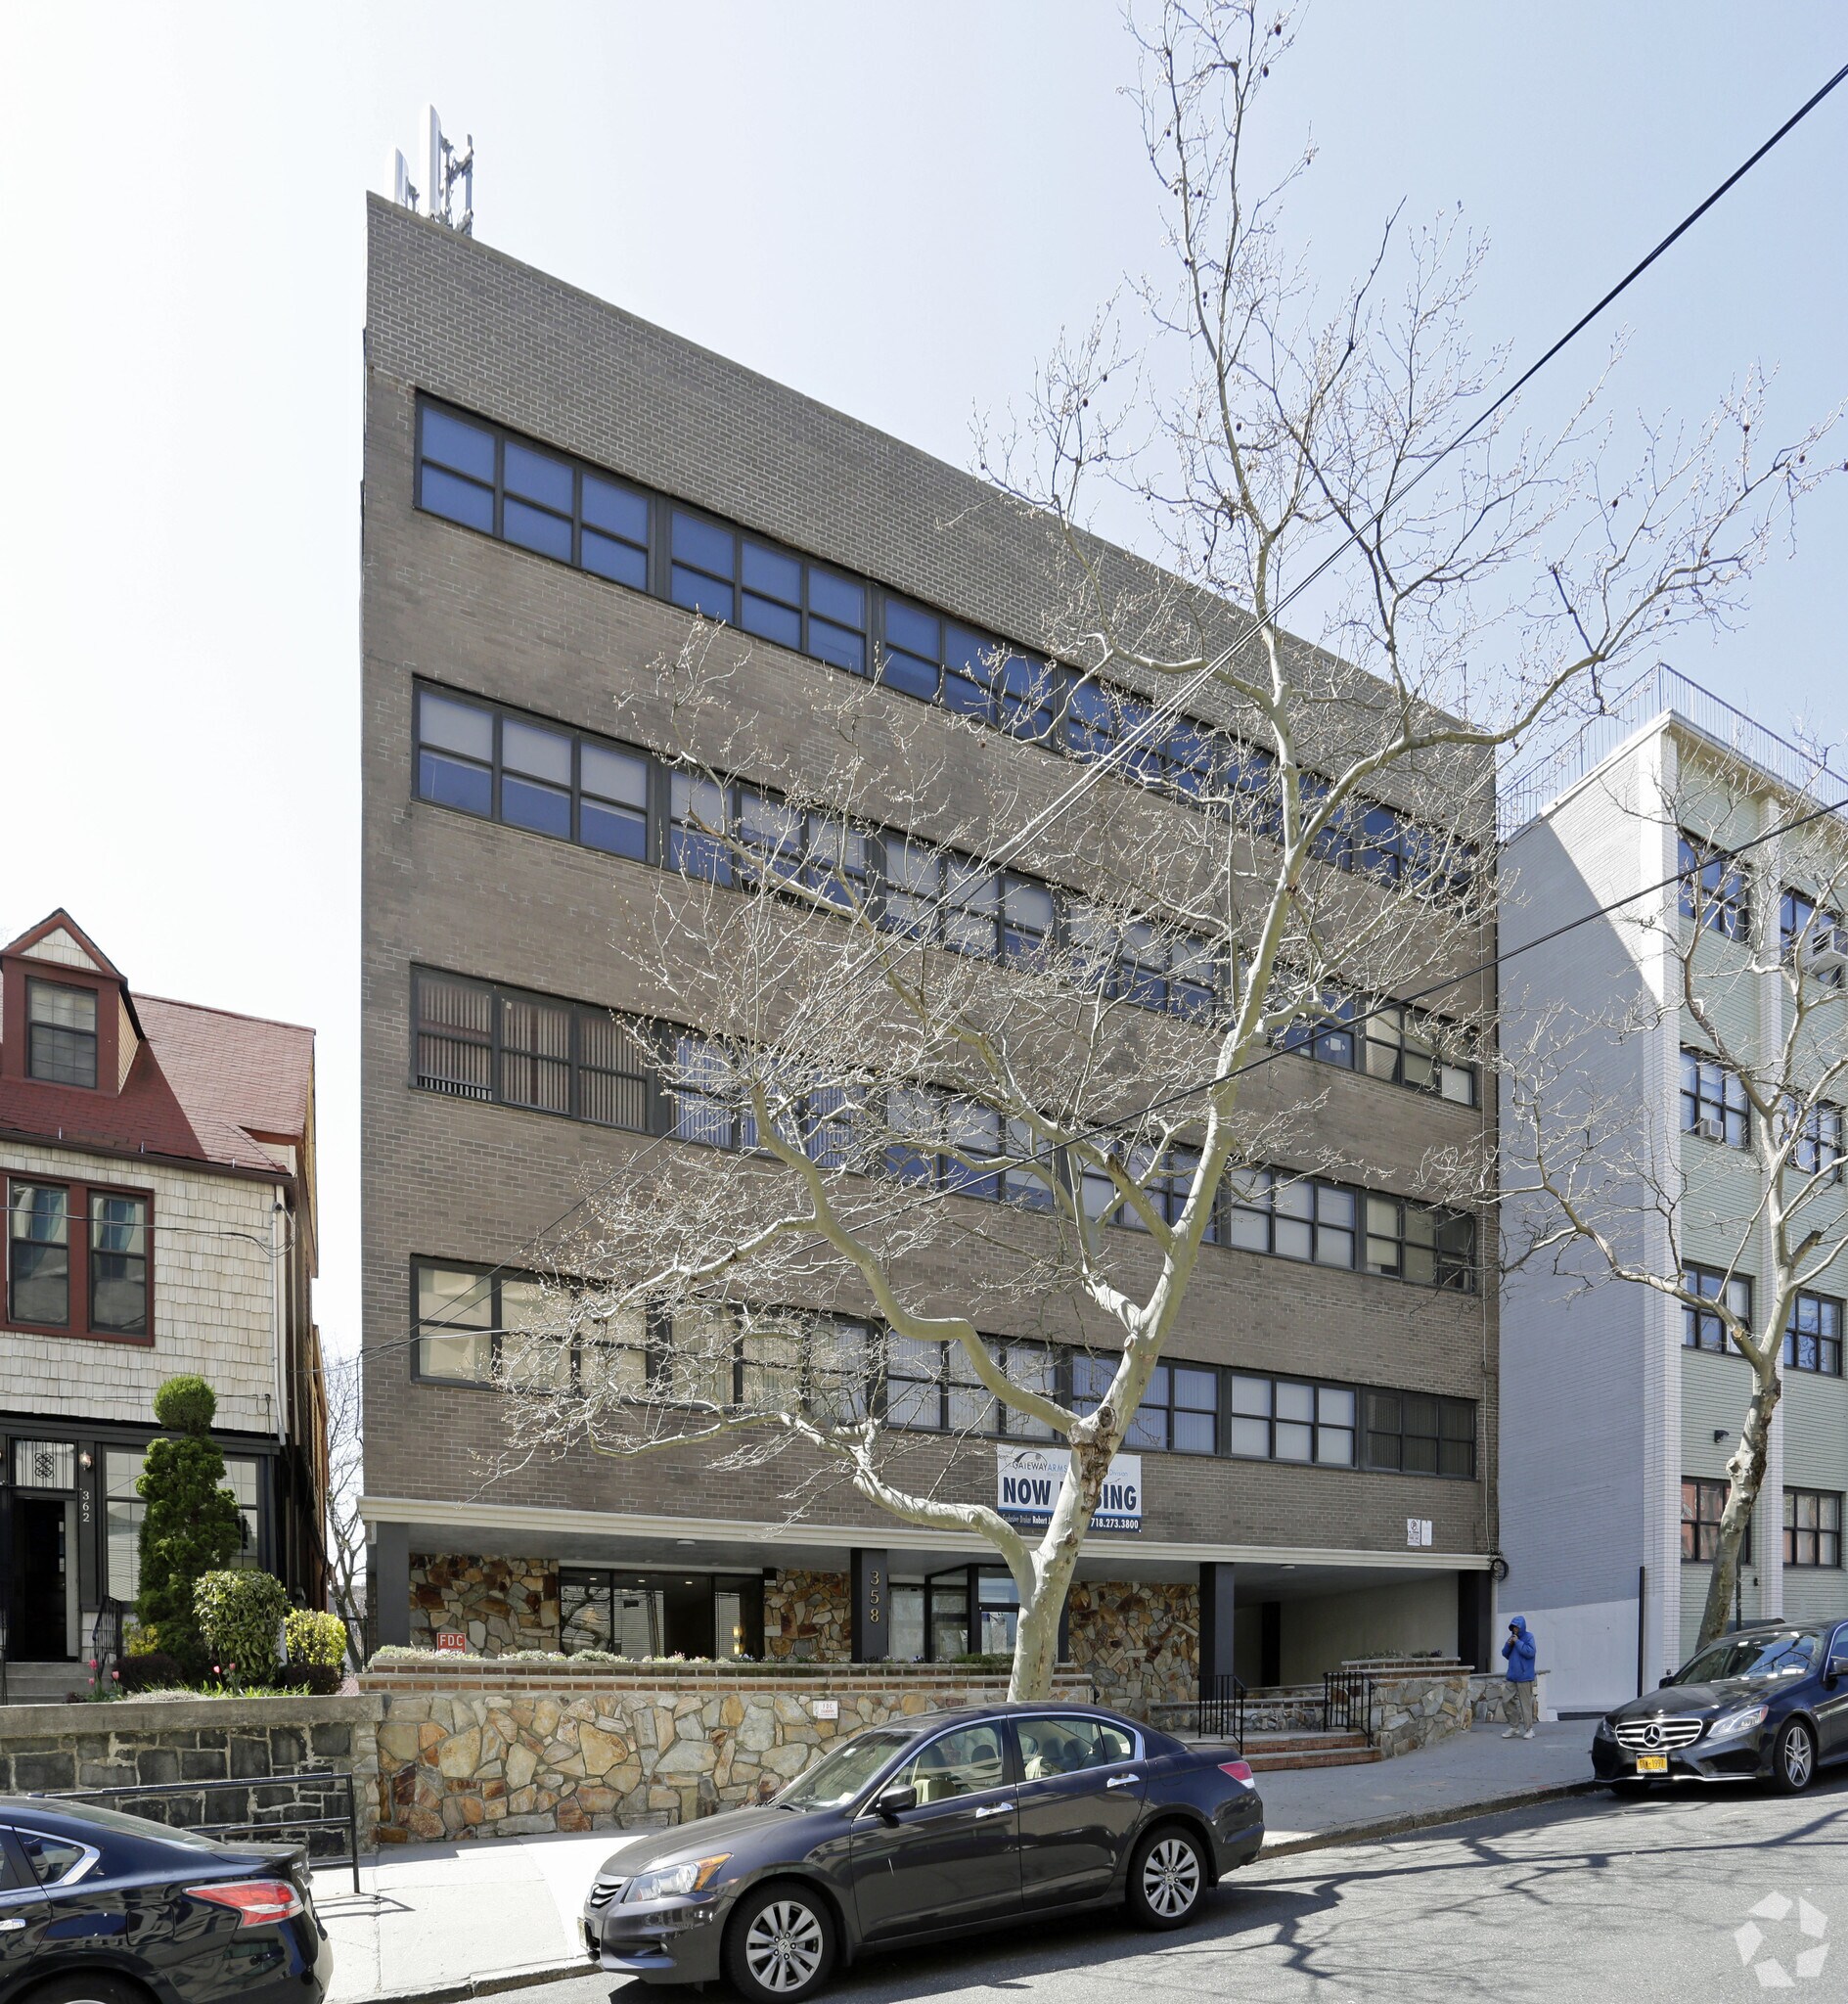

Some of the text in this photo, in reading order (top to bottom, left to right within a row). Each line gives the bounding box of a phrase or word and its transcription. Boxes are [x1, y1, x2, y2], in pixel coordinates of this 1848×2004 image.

[1108, 1469, 1129, 1478] Division
[1003, 1476, 1052, 1506] NOW
[1032, 1515, 1048, 1526] Robert
[1090, 1517, 1139, 1529] 718.273.3800
[870, 1570, 879, 1623] 358
[439, 1634, 464, 1647] FDC
